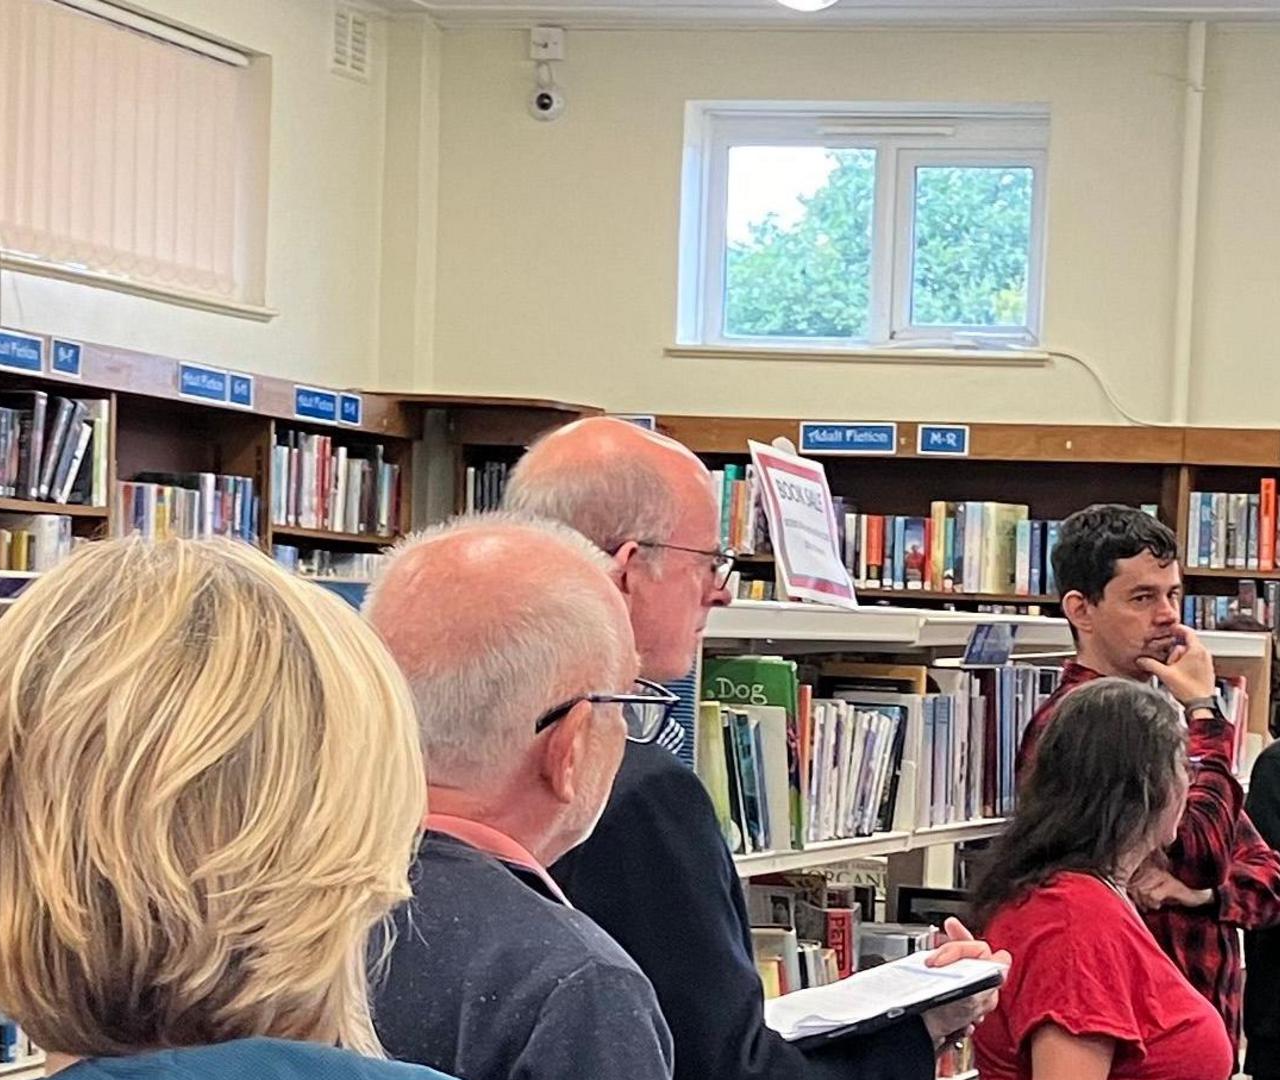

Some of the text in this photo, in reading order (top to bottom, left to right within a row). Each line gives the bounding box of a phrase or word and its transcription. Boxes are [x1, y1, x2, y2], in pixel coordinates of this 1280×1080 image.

[808, 428, 889, 443] Adult Fiction
[715, 677, 768, 705] Dog
